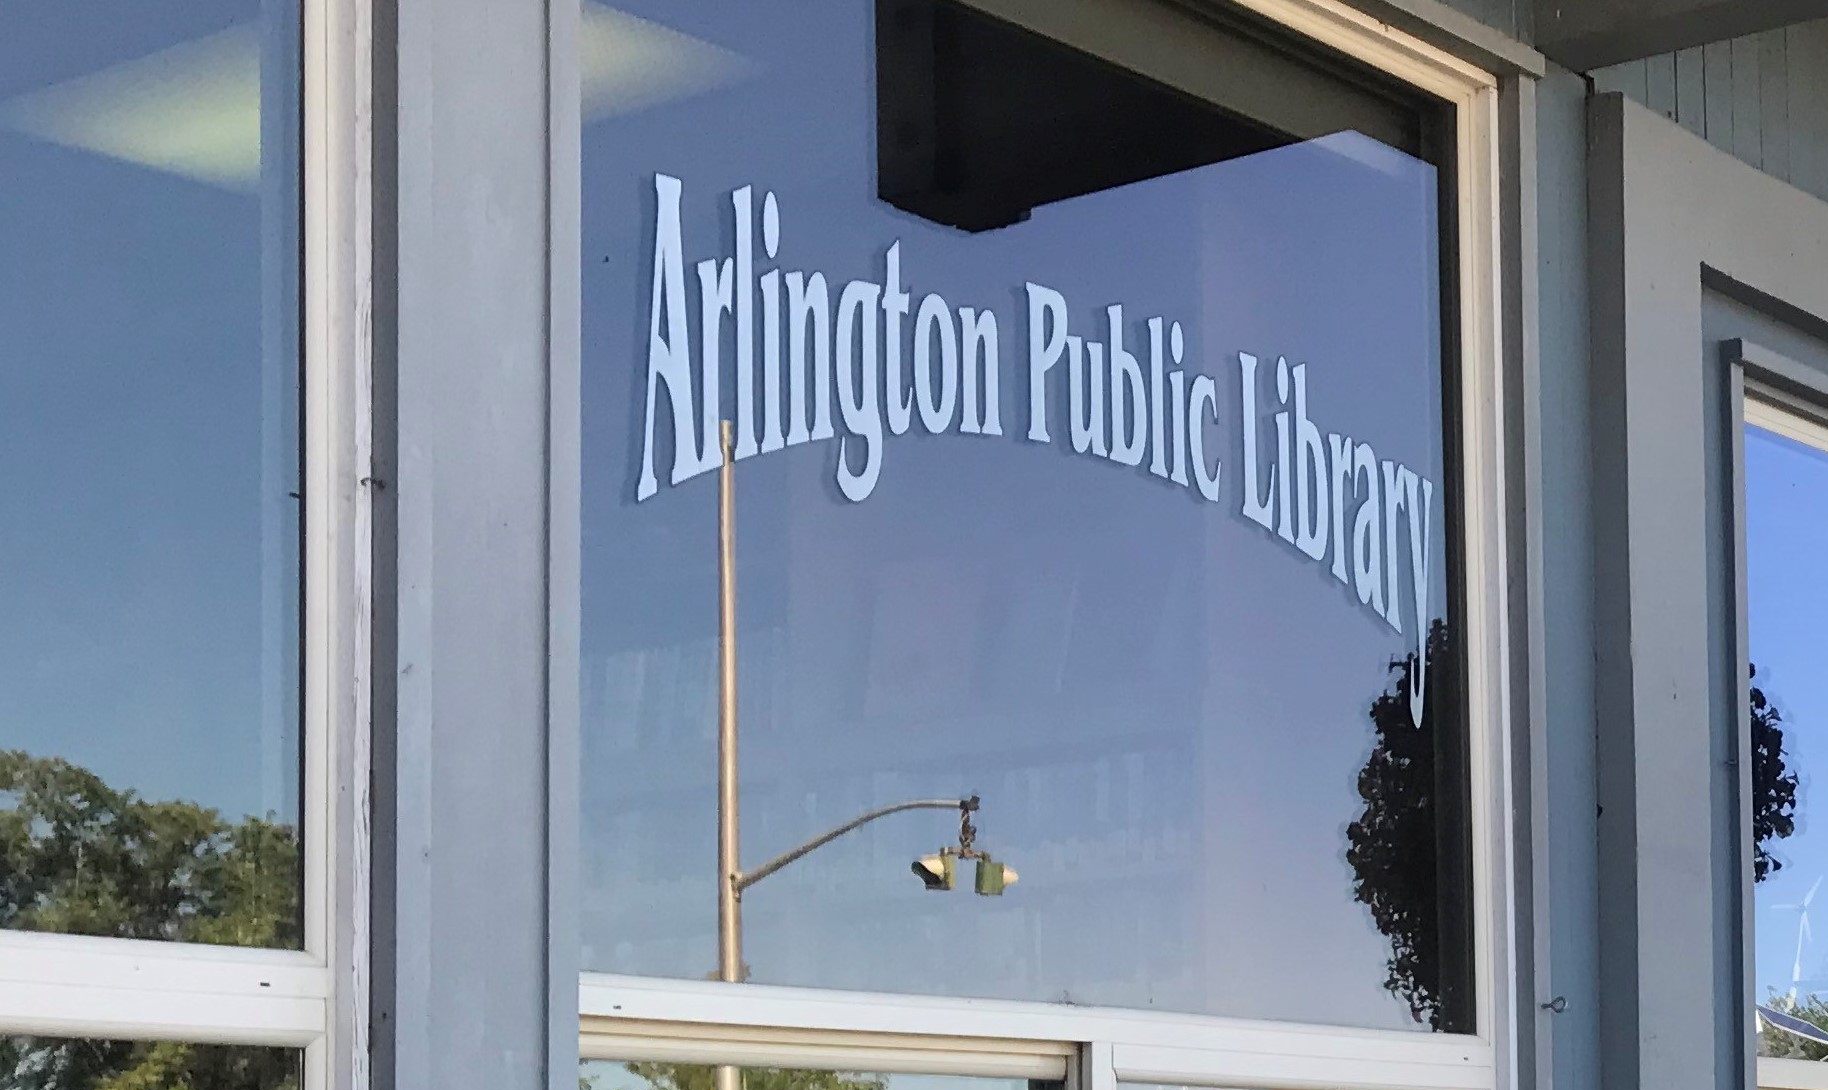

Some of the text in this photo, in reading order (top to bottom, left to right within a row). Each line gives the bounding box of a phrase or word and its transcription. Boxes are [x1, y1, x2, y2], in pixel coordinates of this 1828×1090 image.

[637, 173, 1434, 728] Arlington Public Library
